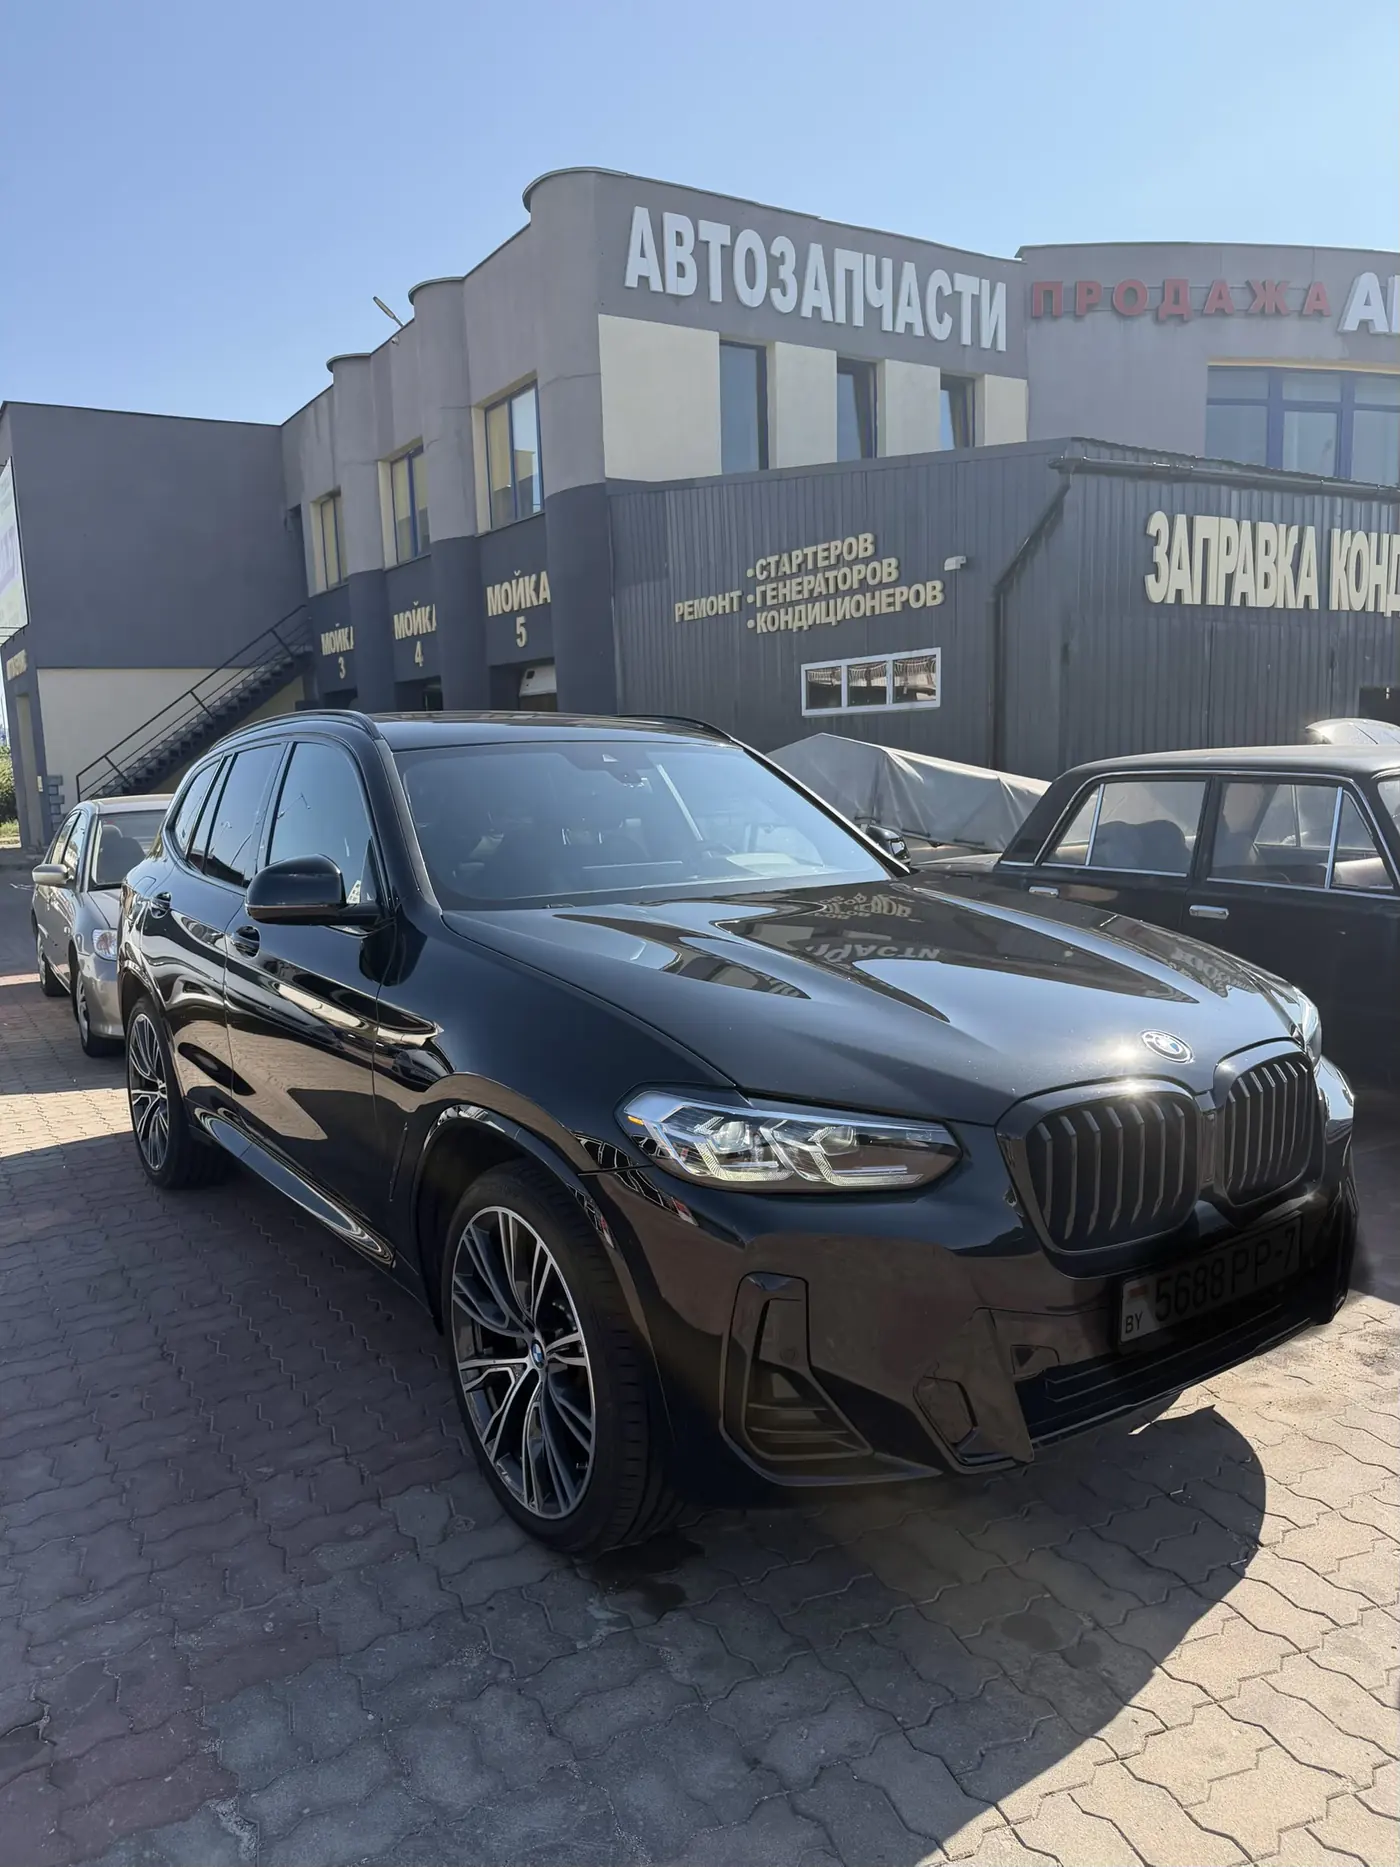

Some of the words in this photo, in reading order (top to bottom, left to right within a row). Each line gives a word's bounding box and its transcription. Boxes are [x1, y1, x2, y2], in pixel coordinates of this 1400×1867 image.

[624, 205, 1007, 352] АВТОЗАПЧАСТИ
[1031, 277, 1332, 322] ПРОДАЖА
[1338, 271, 1400, 336] А
[755, 532, 876, 581] СТАРТЕРОВ
[1144, 510, 1320, 610] ЗАПРАВКА
[486, 569, 551, 617] МОЙКА
[674, 590, 743, 623] РЕМОНТ
[755, 557, 900, 608] ГЕНЕРАТОРОВ
[756, 580, 946, 634] КОНДИЦИОНЕРОВ
[414, 641, 424, 667] 4
[516, 616, 527, 648] 5
[338, 656, 346, 679] 3
[1125, 1310, 1143, 1334] BY
